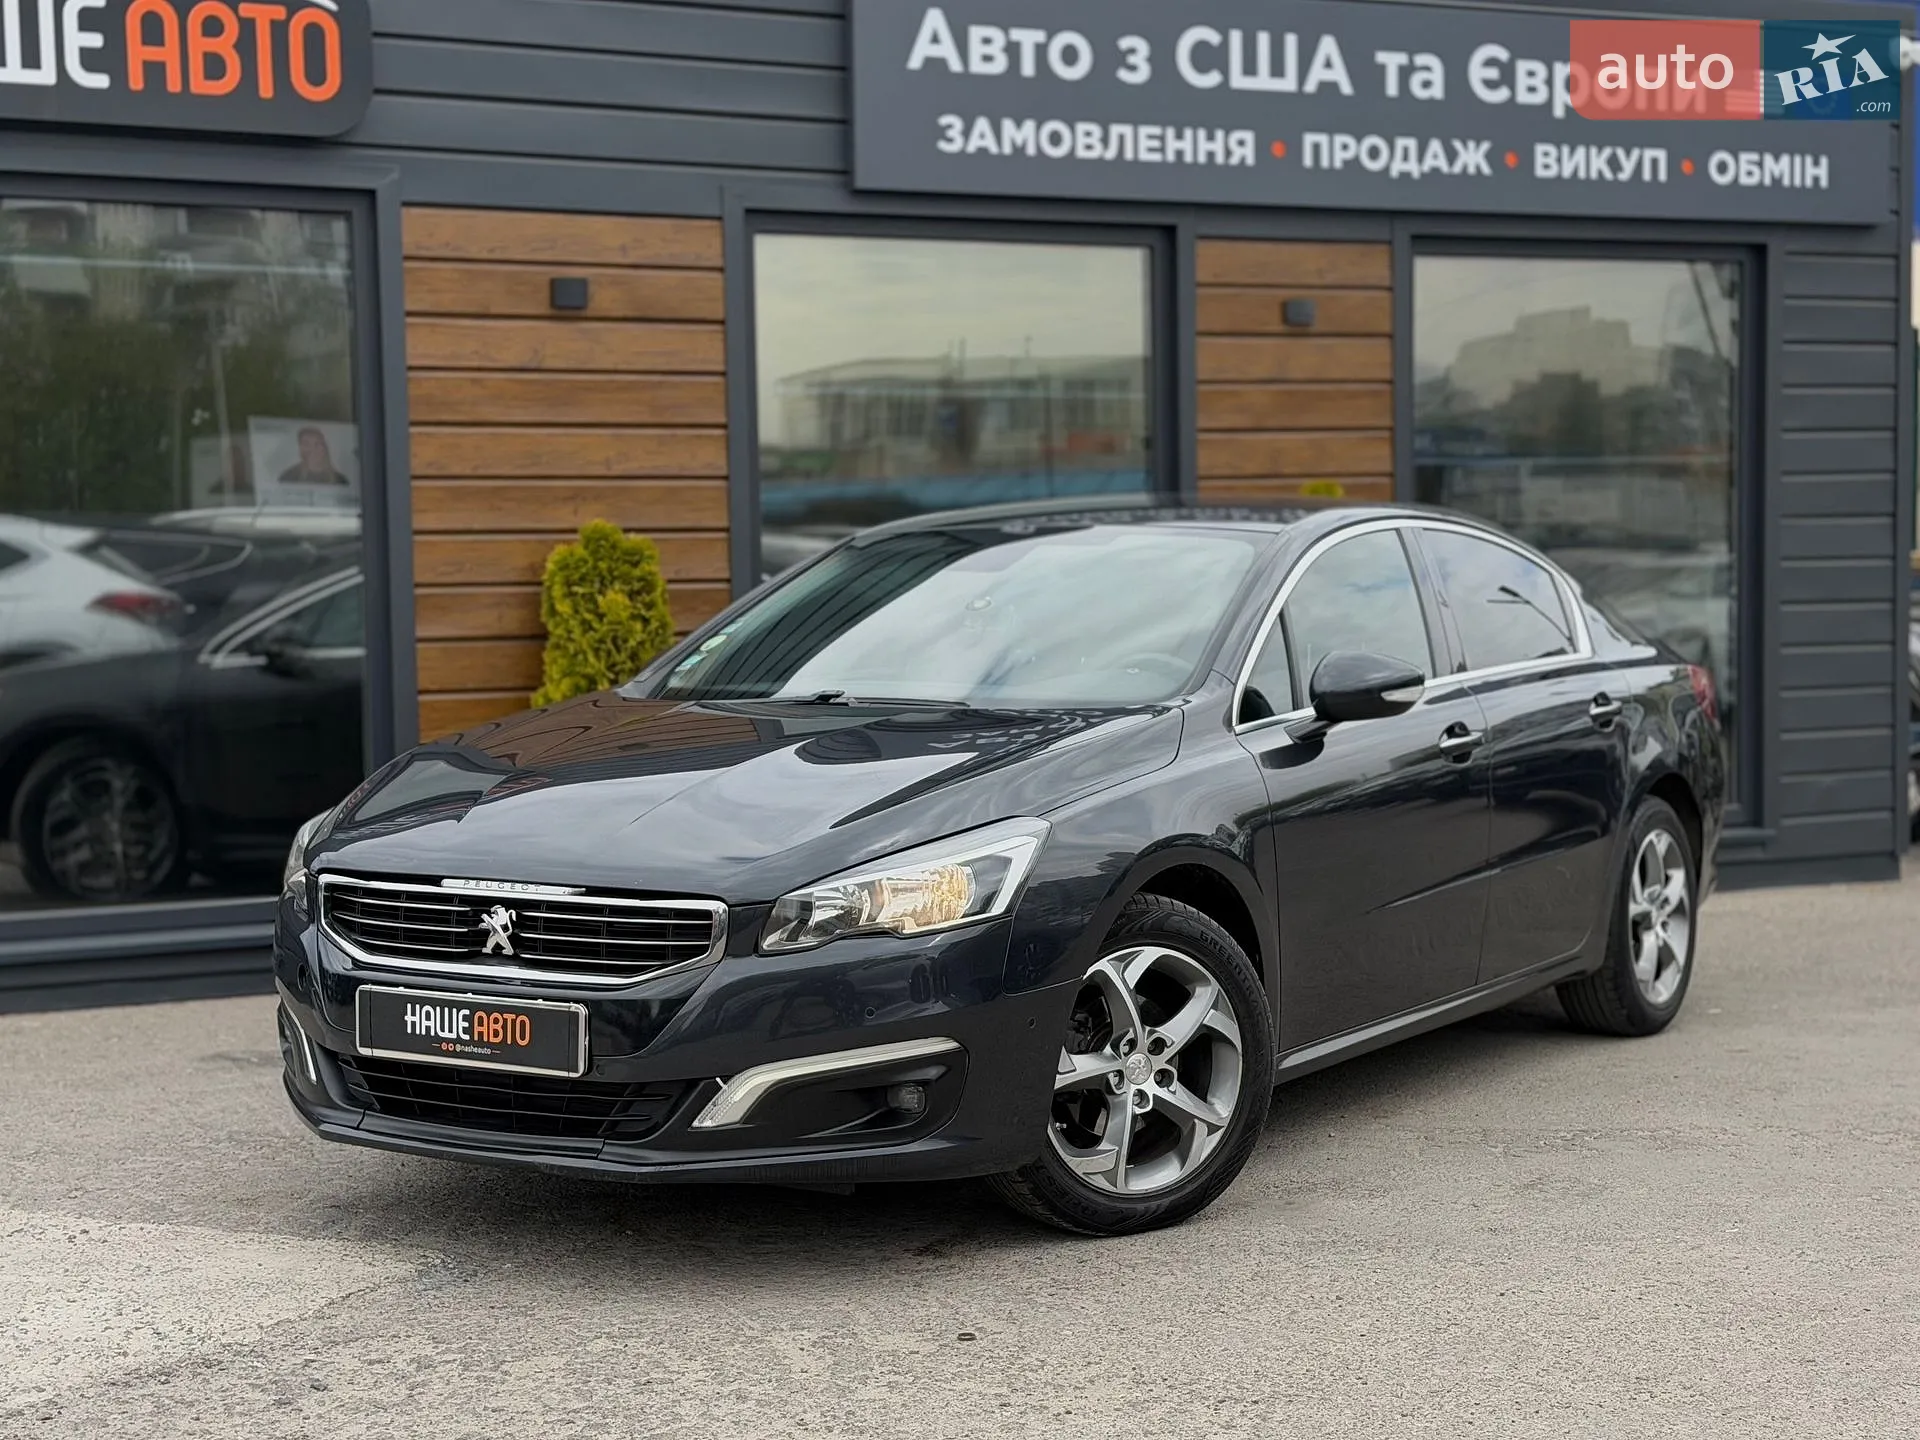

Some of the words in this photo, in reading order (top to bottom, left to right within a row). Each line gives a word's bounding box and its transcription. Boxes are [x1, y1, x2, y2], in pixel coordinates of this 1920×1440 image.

[125, 0, 342, 101] АВТО
[906, 7, 1093, 82] Авто
[1115, 35, 1152, 85] з
[1175, 25, 1354, 95] США
[1375, 51, 1445, 100] та
[936, 114, 1256, 167] ЗАМОВЛЕННЯ
[1303, 132, 1493, 179] ПРОДАЖ
[1534, 143, 1668, 184] ВИКУП
[1709, 151, 1830, 189] ОБМІН
[404, 1003, 470, 1040] НАШЕ
[473, 1010, 531, 1046] АВТО
